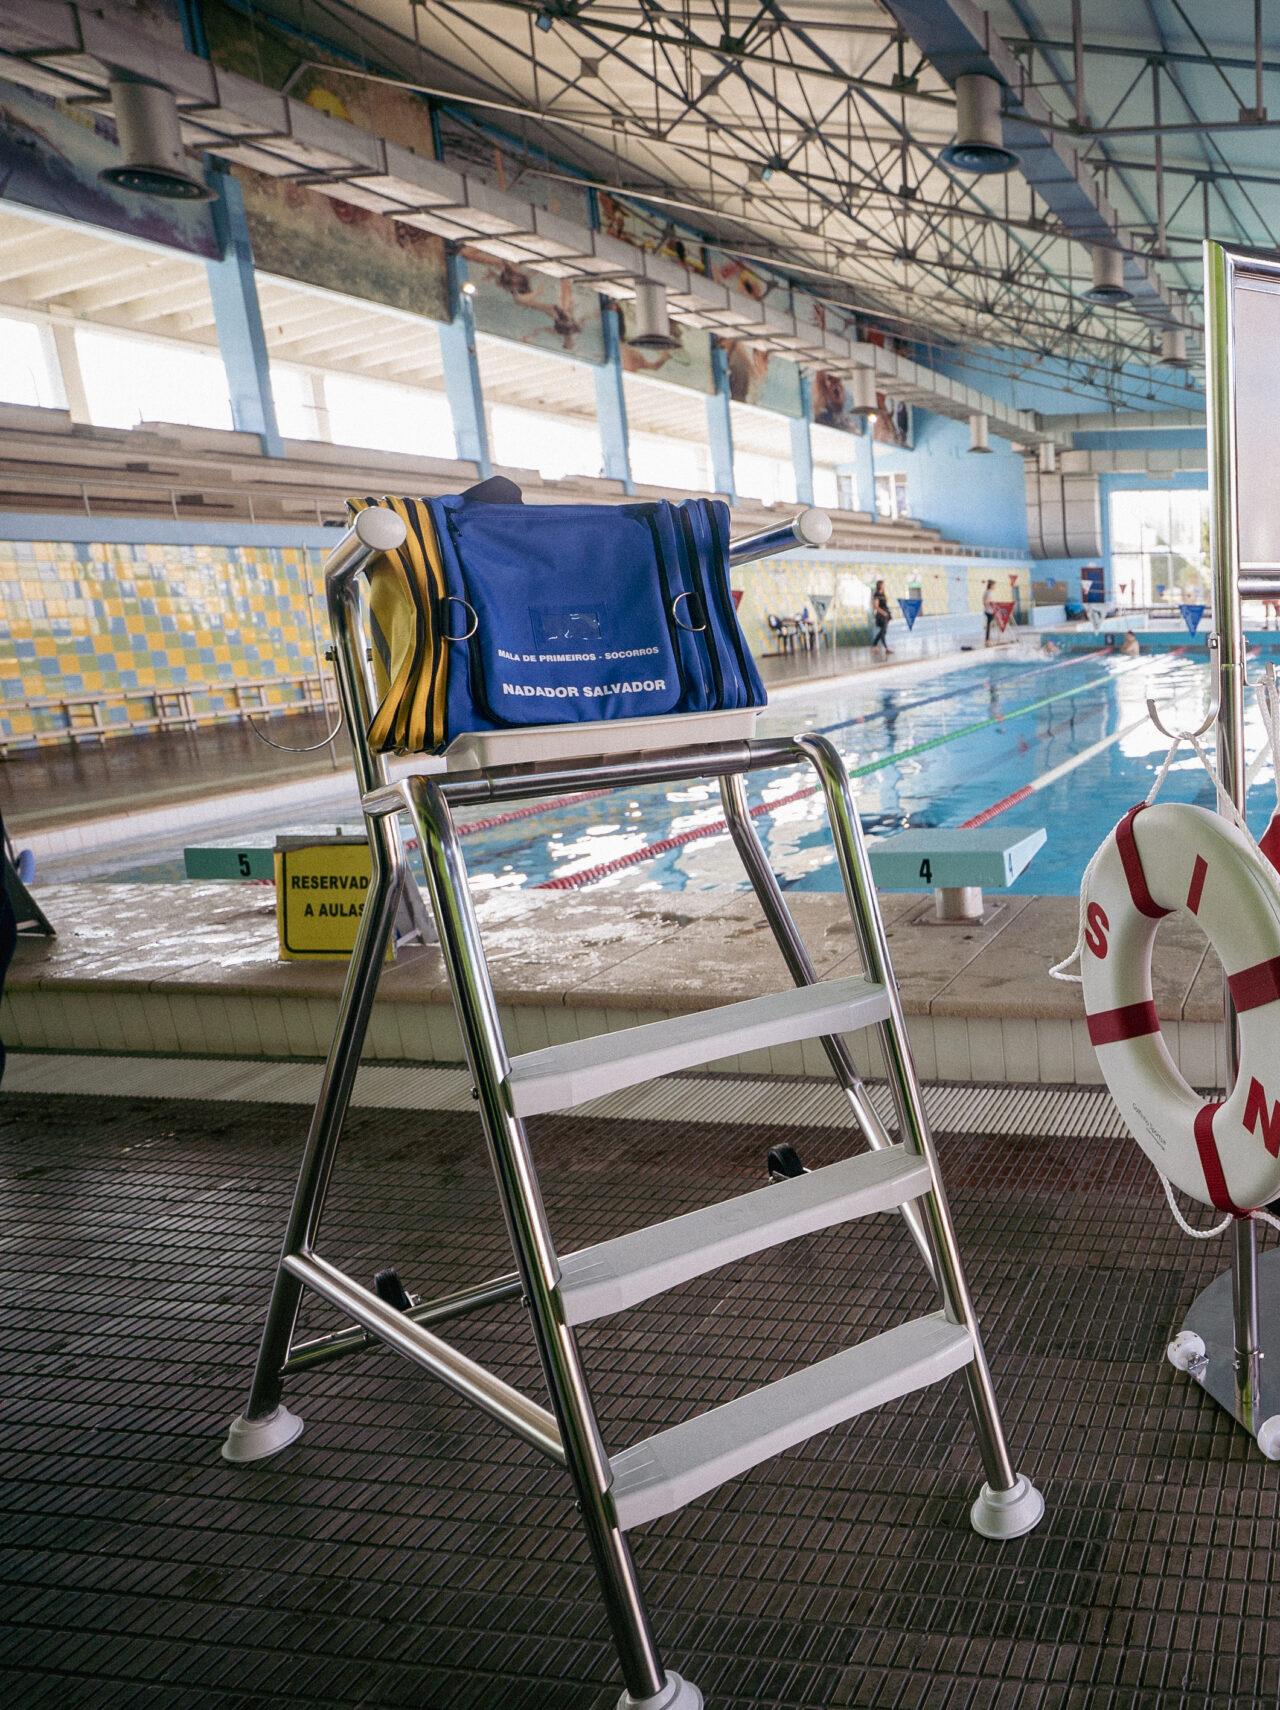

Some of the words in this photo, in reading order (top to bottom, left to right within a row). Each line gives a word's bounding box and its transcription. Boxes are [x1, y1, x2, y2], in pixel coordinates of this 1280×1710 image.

[498, 649, 521, 662] MALA
[522, 654, 537, 662] DE
[539, 653, 596, 662] PRIMEIROS
[604, 646, 660, 660] SOCORROS
[502, 683, 580, 698] NADADOR
[582, 679, 666, 697] SALVADOR
[238, 853, 251, 876] 5
[919, 858, 932, 884] 4
[292, 876, 370, 889] RESERVAD
[304, 903, 315, 917] A
[319, 903, 364, 917] AULAS
[1085, 901, 1109, 960] S
